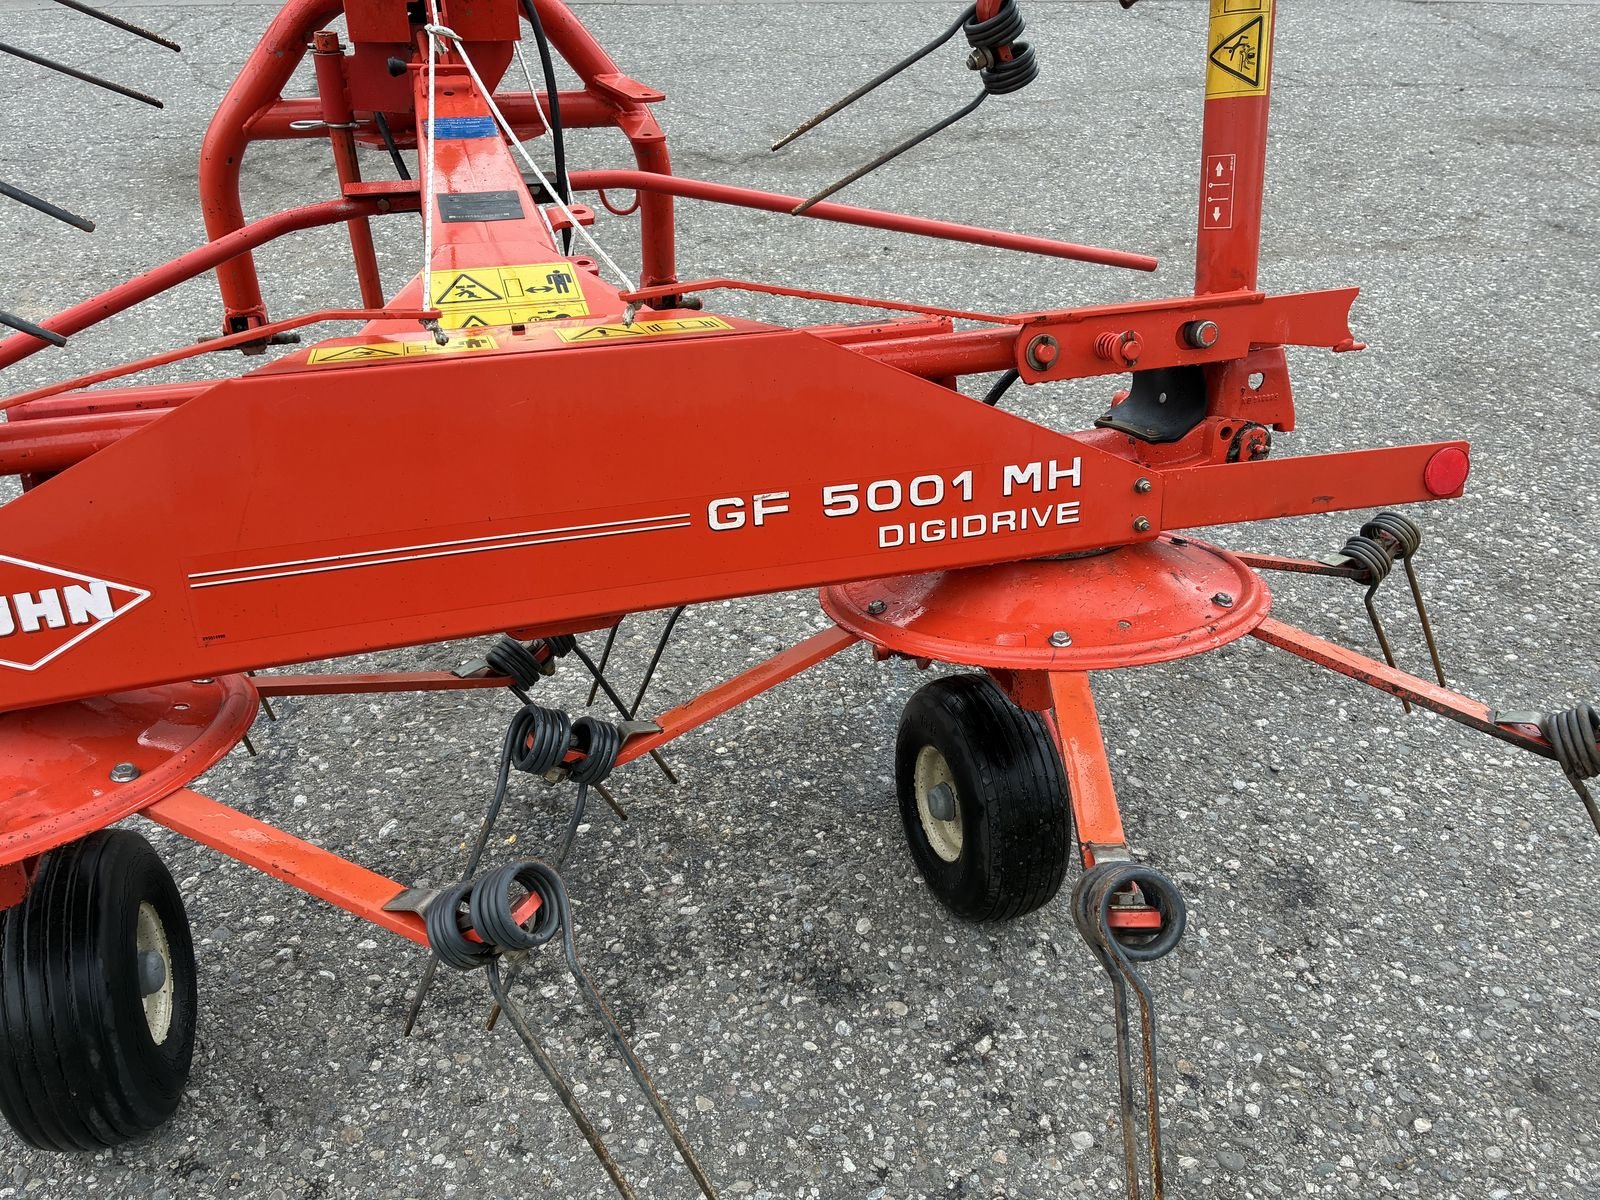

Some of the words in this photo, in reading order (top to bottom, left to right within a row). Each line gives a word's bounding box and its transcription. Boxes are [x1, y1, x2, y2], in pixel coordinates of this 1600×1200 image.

[707, 491, 790, 531] GF
[822, 470, 973, 517] 5001
[1002, 456, 1081, 496] MH
[878, 501, 1080, 548] DIGIDRIVE
